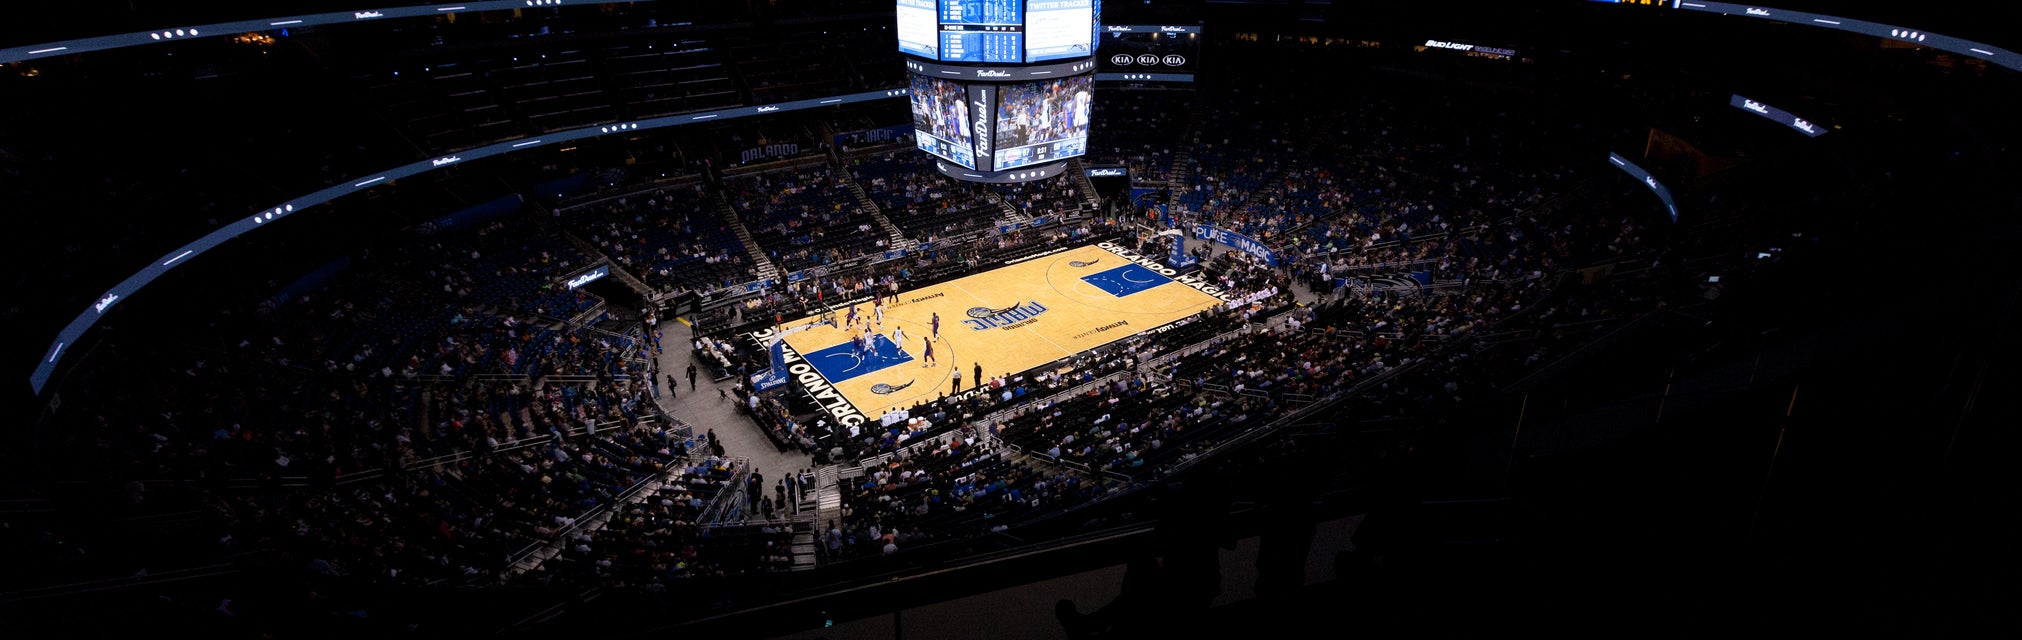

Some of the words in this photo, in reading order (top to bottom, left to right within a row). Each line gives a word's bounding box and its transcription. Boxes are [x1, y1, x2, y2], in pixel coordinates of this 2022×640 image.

[1029, 1, 1059, 10] TWITTER
[1445, 42, 1474, 51] LIGHT
[974, 89, 990, 158] FanDuel.com
[1241, 238, 1271, 262] MAGIC
[1097, 242, 1176, 276] ORLANDO
[1174, 275, 1231, 302] MAGIC
[789, 363, 865, 429] ORLANDO
